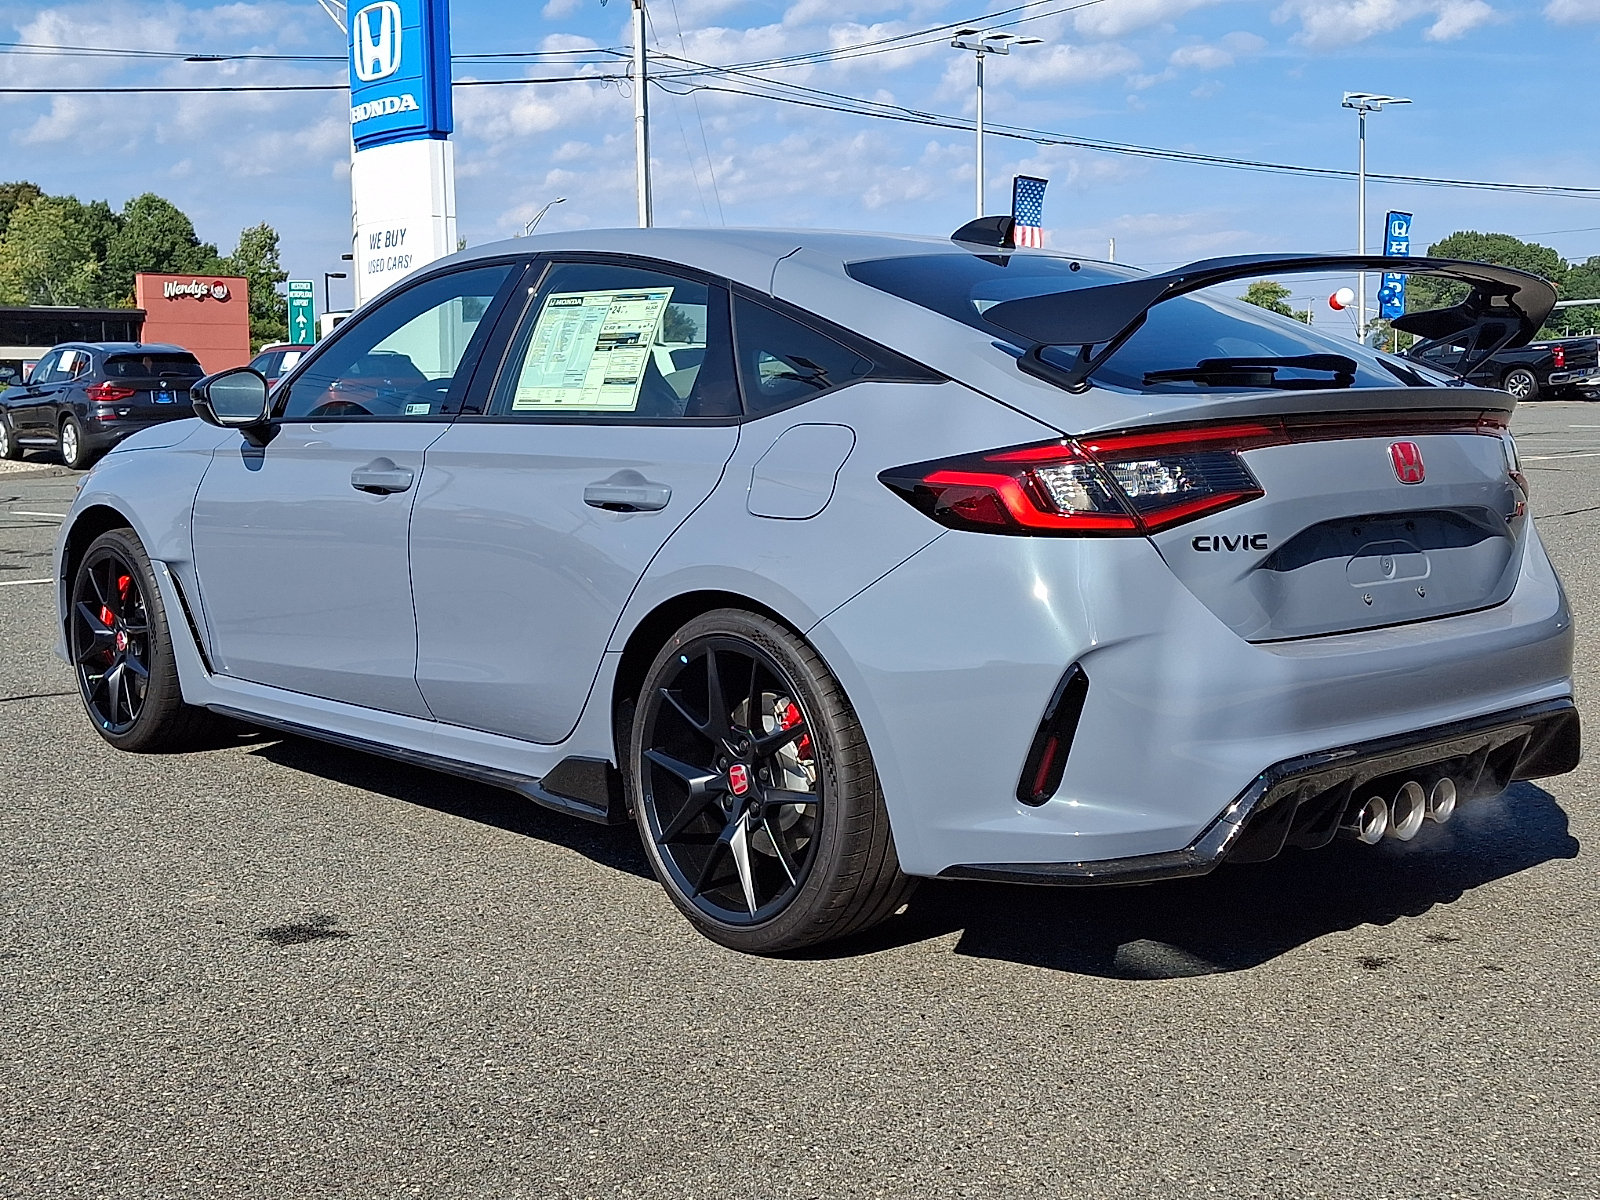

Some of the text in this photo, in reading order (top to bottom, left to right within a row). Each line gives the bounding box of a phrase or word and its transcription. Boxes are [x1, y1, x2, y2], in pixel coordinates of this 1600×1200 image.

[351, 93, 420, 124] HONDA
[369, 227, 407, 250] WE BUY
[368, 254, 413, 274] USED CARS!
[163, 279, 209, 299] Wendy's
[555, 298, 582, 306] HONDA
[1192, 533, 1268, 552] CIVIC
